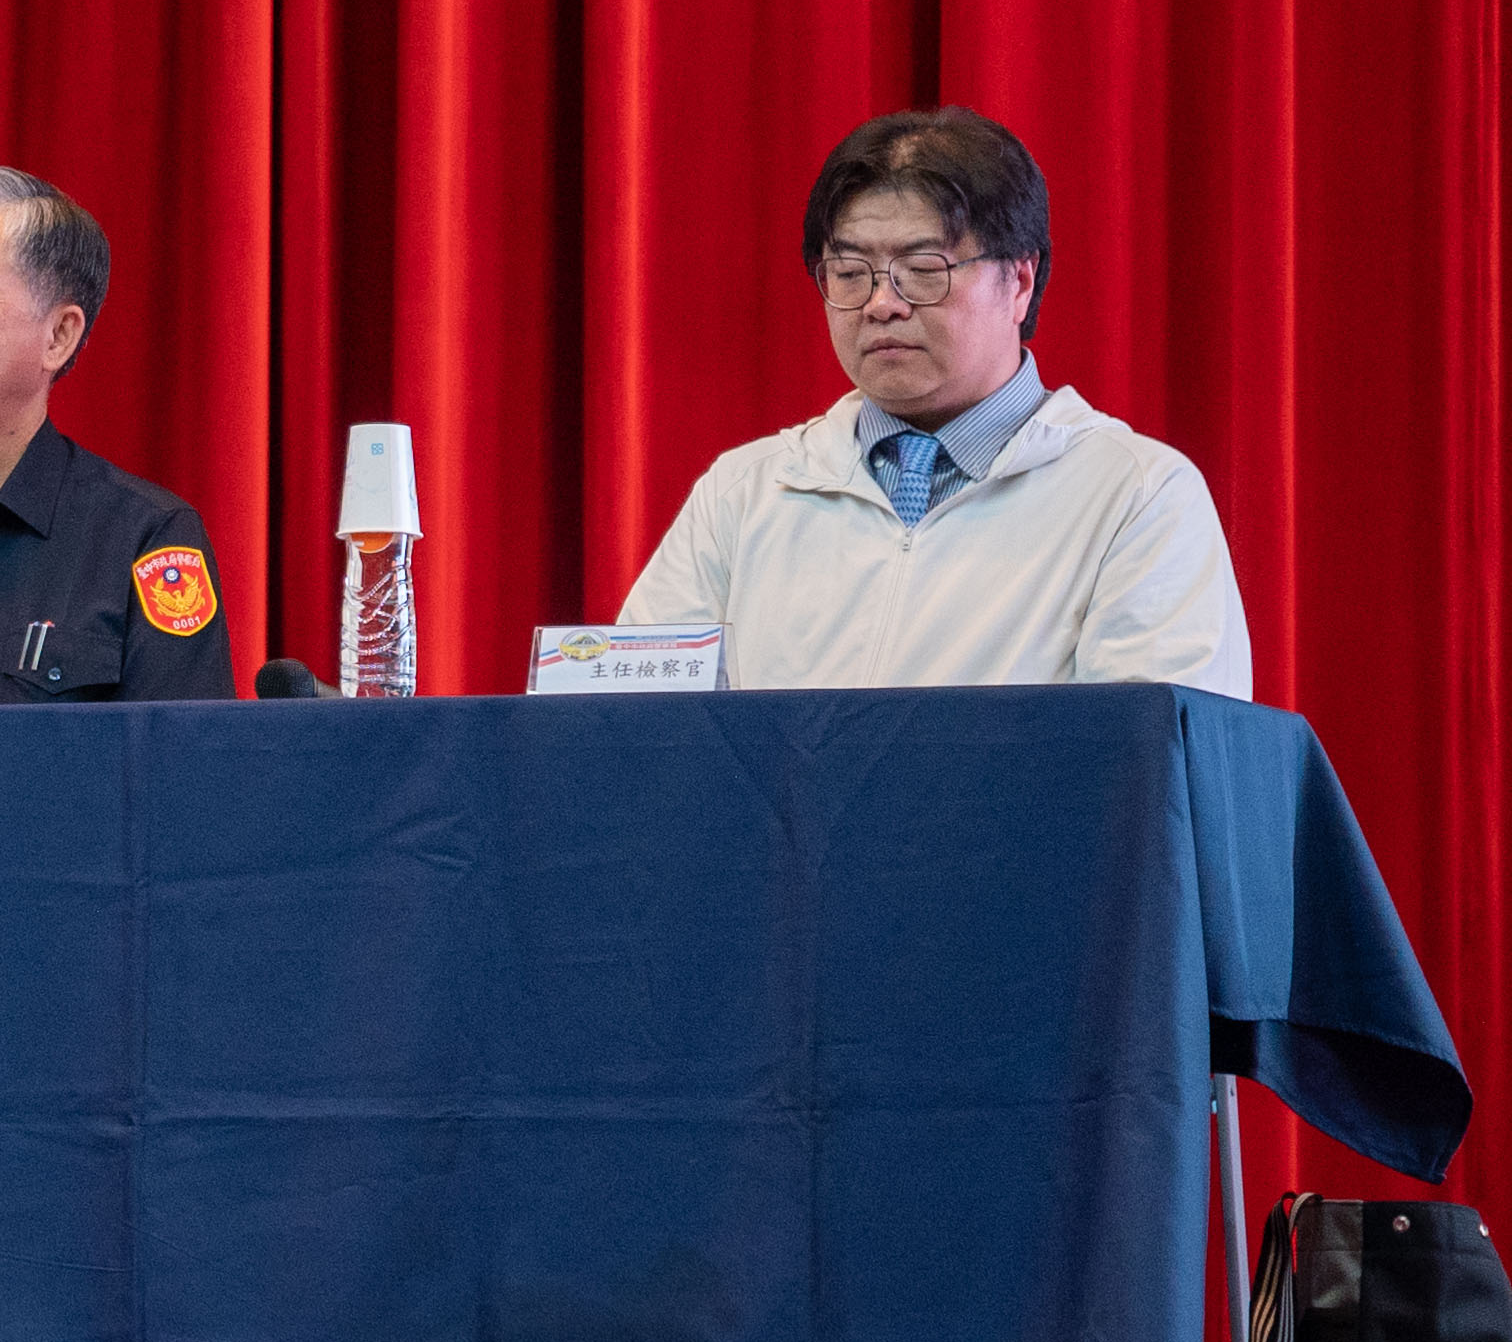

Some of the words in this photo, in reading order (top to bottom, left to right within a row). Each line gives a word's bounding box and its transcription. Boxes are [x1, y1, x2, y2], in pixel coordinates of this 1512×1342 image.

[172, 615, 201, 630] 0001
[590, 659, 704, 679] 主任檢察官
